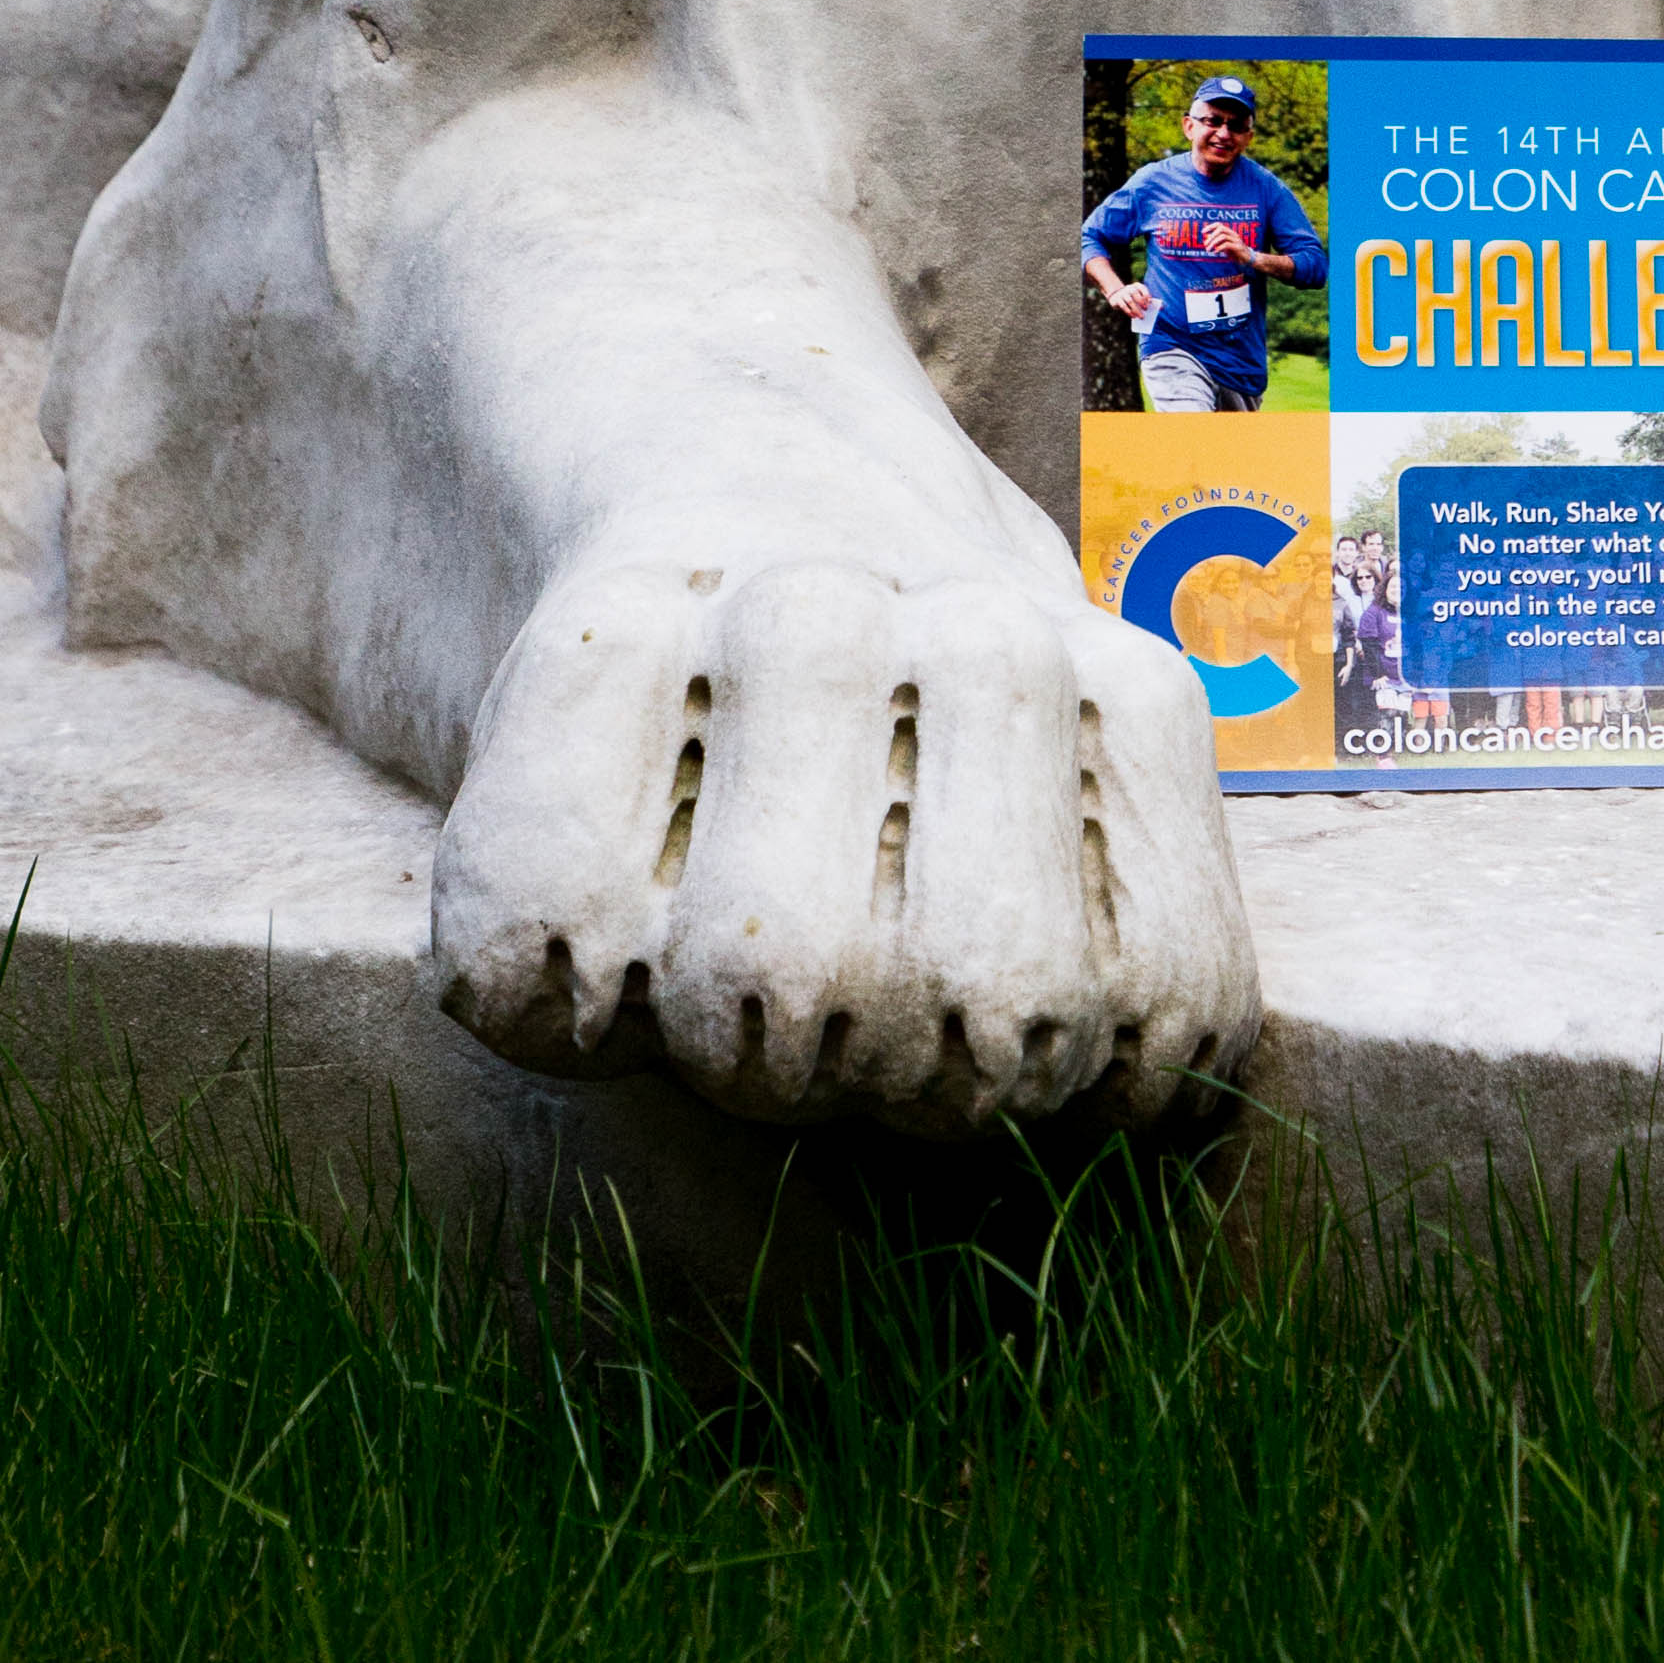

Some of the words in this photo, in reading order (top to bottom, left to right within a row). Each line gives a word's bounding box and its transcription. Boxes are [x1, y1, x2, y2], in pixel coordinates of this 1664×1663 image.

[1384, 125, 1469, 155] THE
[1498, 126, 1599, 155] 14TH
[1382, 168, 1577, 212] COLON
[1159, 207, 1204, 220] COLON
[1206, 208, 1260, 221] CANCER
[1215, 294, 1228, 318] 1
[1431, 501, 1498, 526] Walk,
[1507, 502, 1559, 526] Run,
[1566, 501, 1638, 523] Shake
[1103, 519, 1153, 603] CANCER
[1161, 488, 1310, 529] FOUNDATION
[1459, 533, 1496, 554] No
[1503, 535, 1585, 554] matter
[1592, 532, 1652, 554] what
[1458, 569, 1501, 591] you
[1509, 569, 1580, 588] cover,
[1432, 593, 1521, 623] ground
[1528, 594, 1549, 615] in
[1557, 593, 1598, 616] the
[1605, 599, 1656, 616] race
[1506, 624, 1626, 647] colorectal
